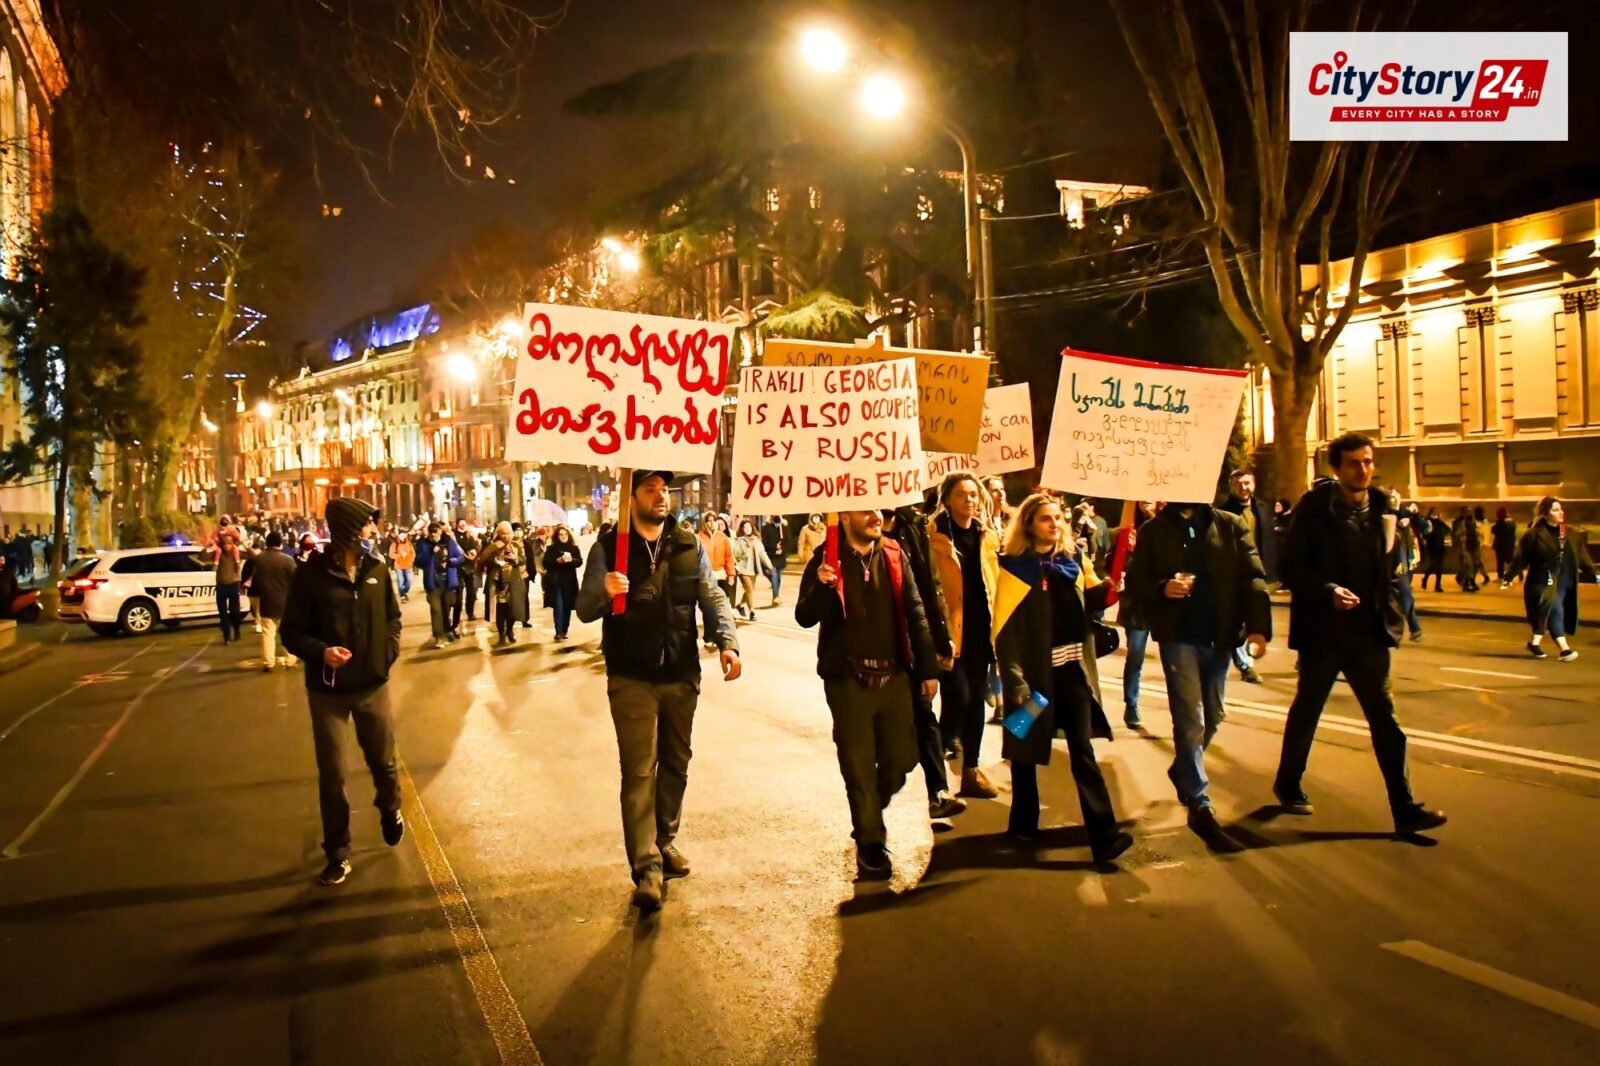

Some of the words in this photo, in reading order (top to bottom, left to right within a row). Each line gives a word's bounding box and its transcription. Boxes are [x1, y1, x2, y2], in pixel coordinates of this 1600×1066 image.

[528, 313, 729, 396] მოღალატე
[824, 363, 913, 394] GEORGIA
[516, 388, 718, 454] მთავრობა
[747, 403, 768, 426] IS
[780, 401, 850, 429] ALSO
[1001, 414, 1031, 427] can
[762, 439, 794, 461] BY
[818, 431, 911, 462] RUSSIA
[981, 431, 1002, 443] ON
[927, 455, 979, 480] PUTINS
[1001, 445, 1029, 461] Dick
[741, 471, 793, 500] YOU
[806, 473, 868, 498] DUMB
[876, 469, 921, 495] FUCK
